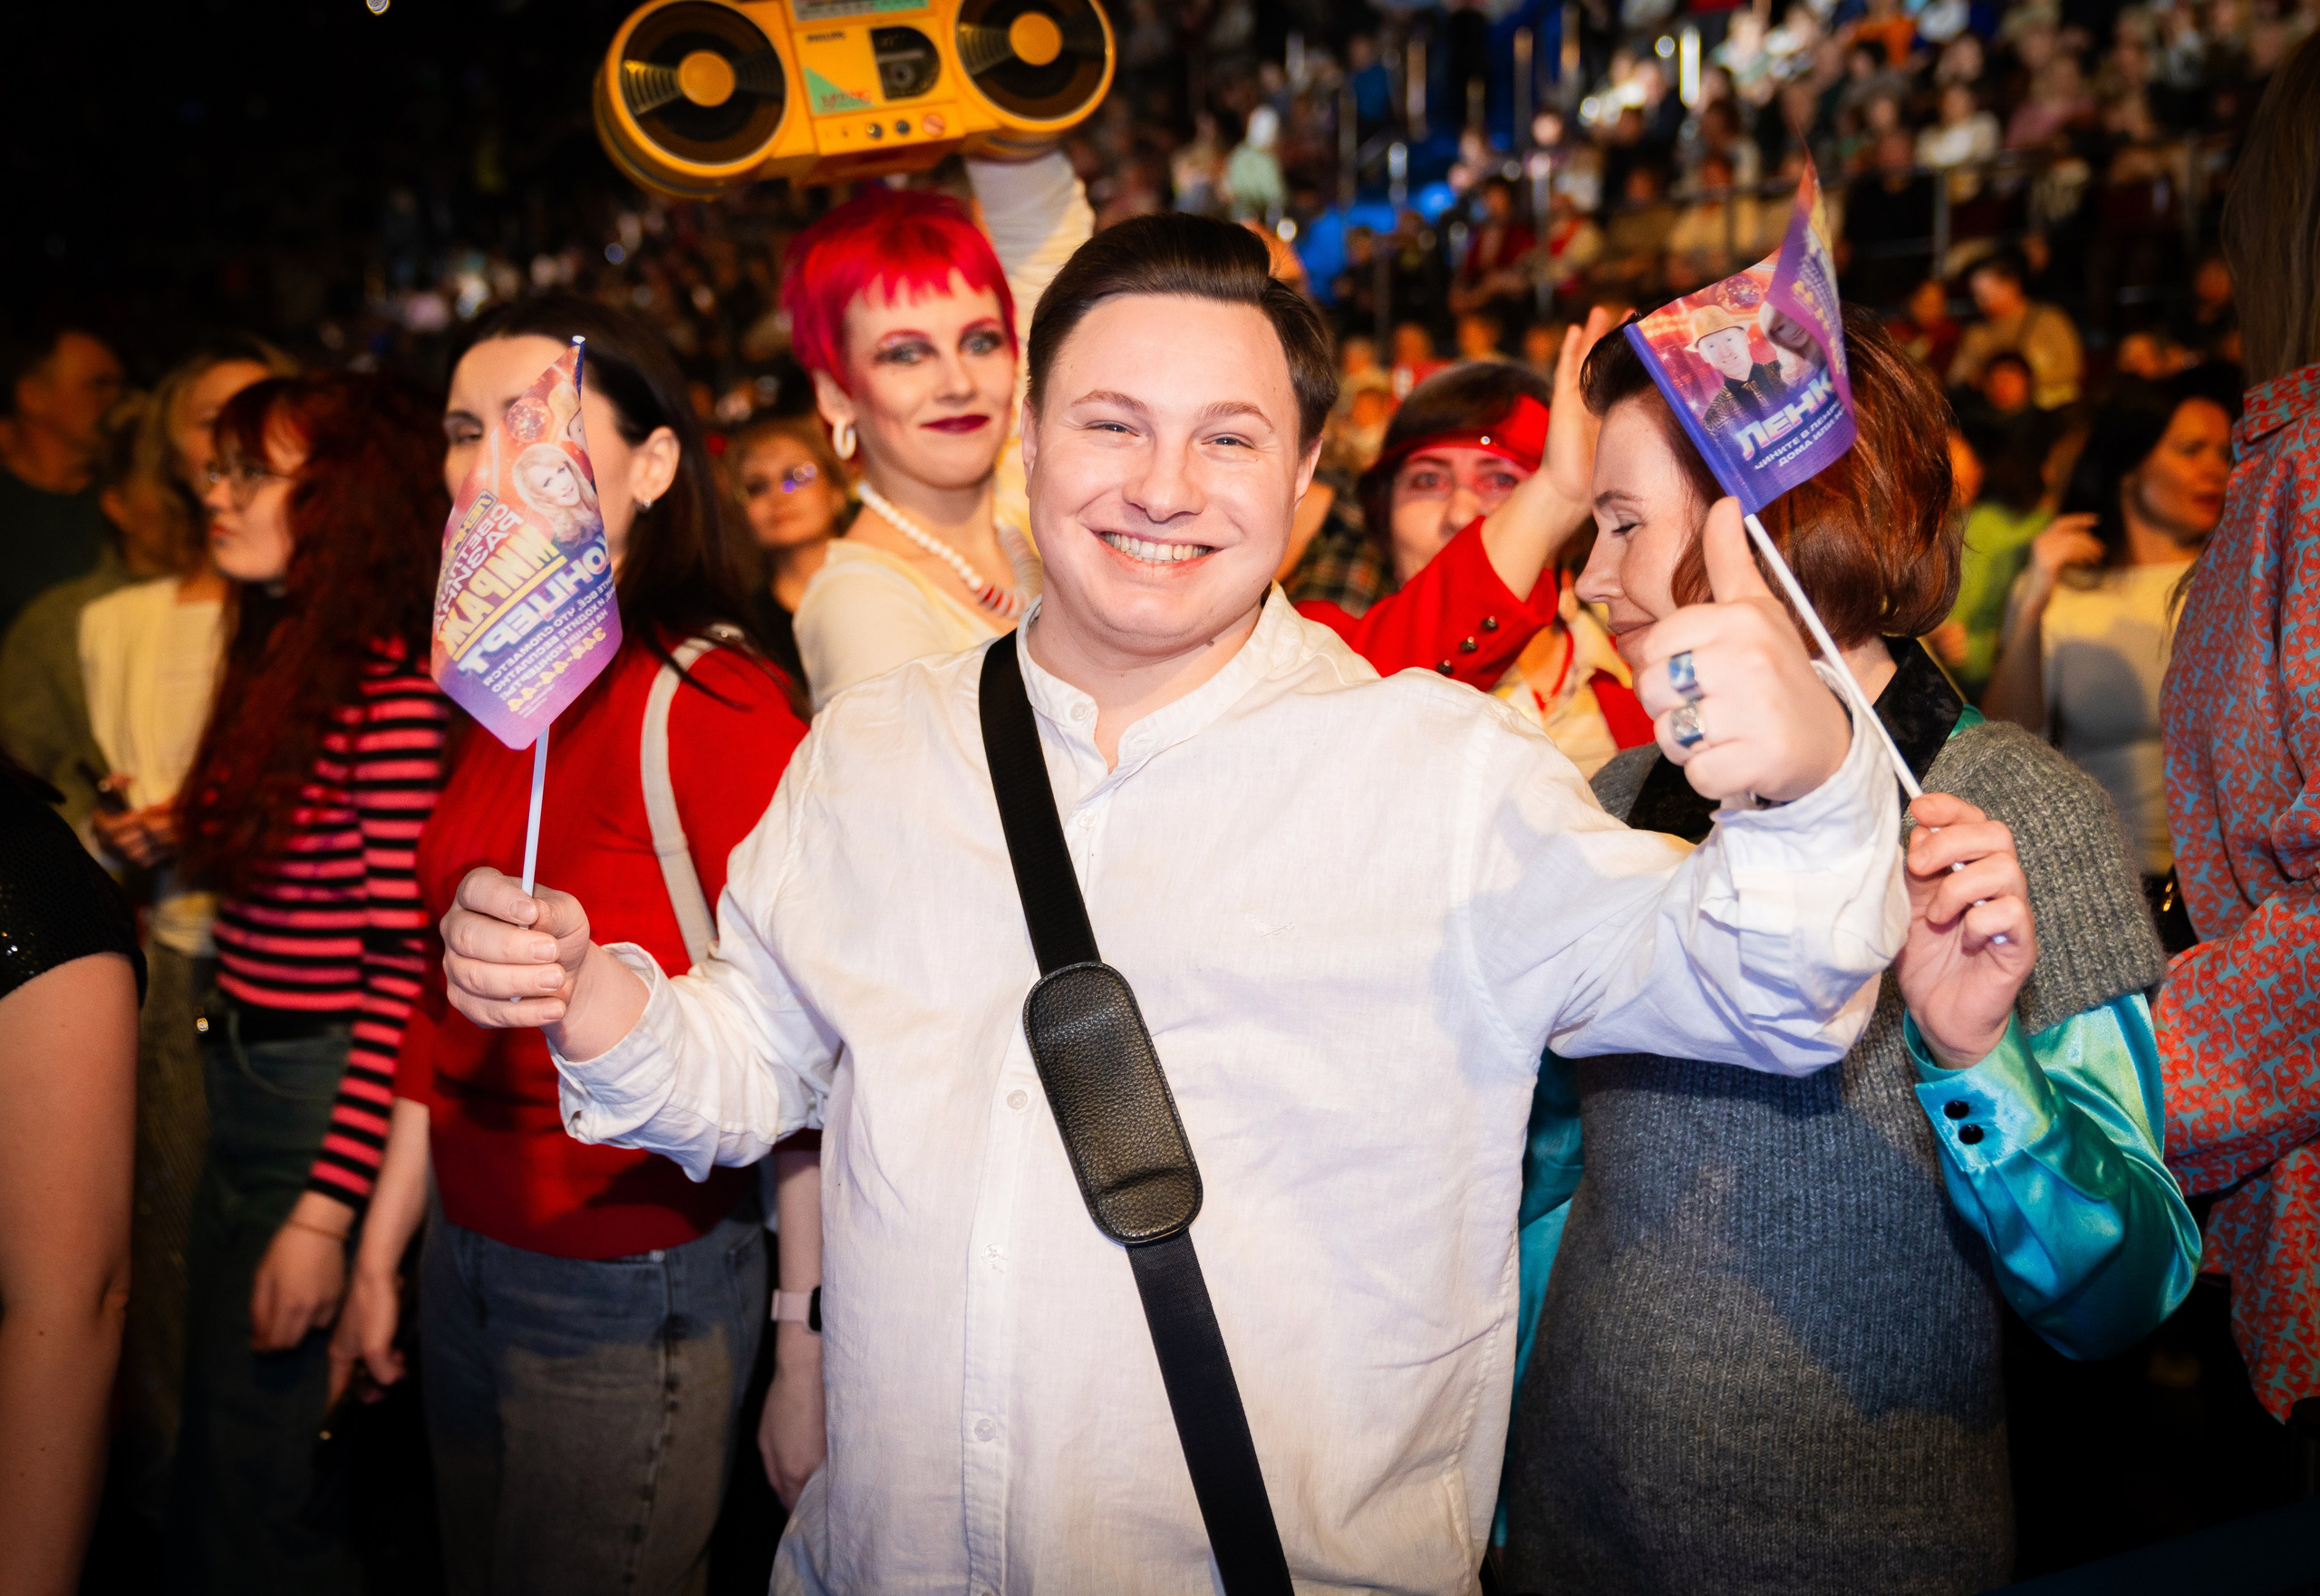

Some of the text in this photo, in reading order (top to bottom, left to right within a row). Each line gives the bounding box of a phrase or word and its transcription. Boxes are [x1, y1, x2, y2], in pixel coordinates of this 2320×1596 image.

[1754, 436, 1801, 469] ЧИНИТЕ
[1800, 429, 1810, 440] В
[1778, 440, 1813, 467] ДОМА
[1812, 418, 1835, 441] ИЛИ
